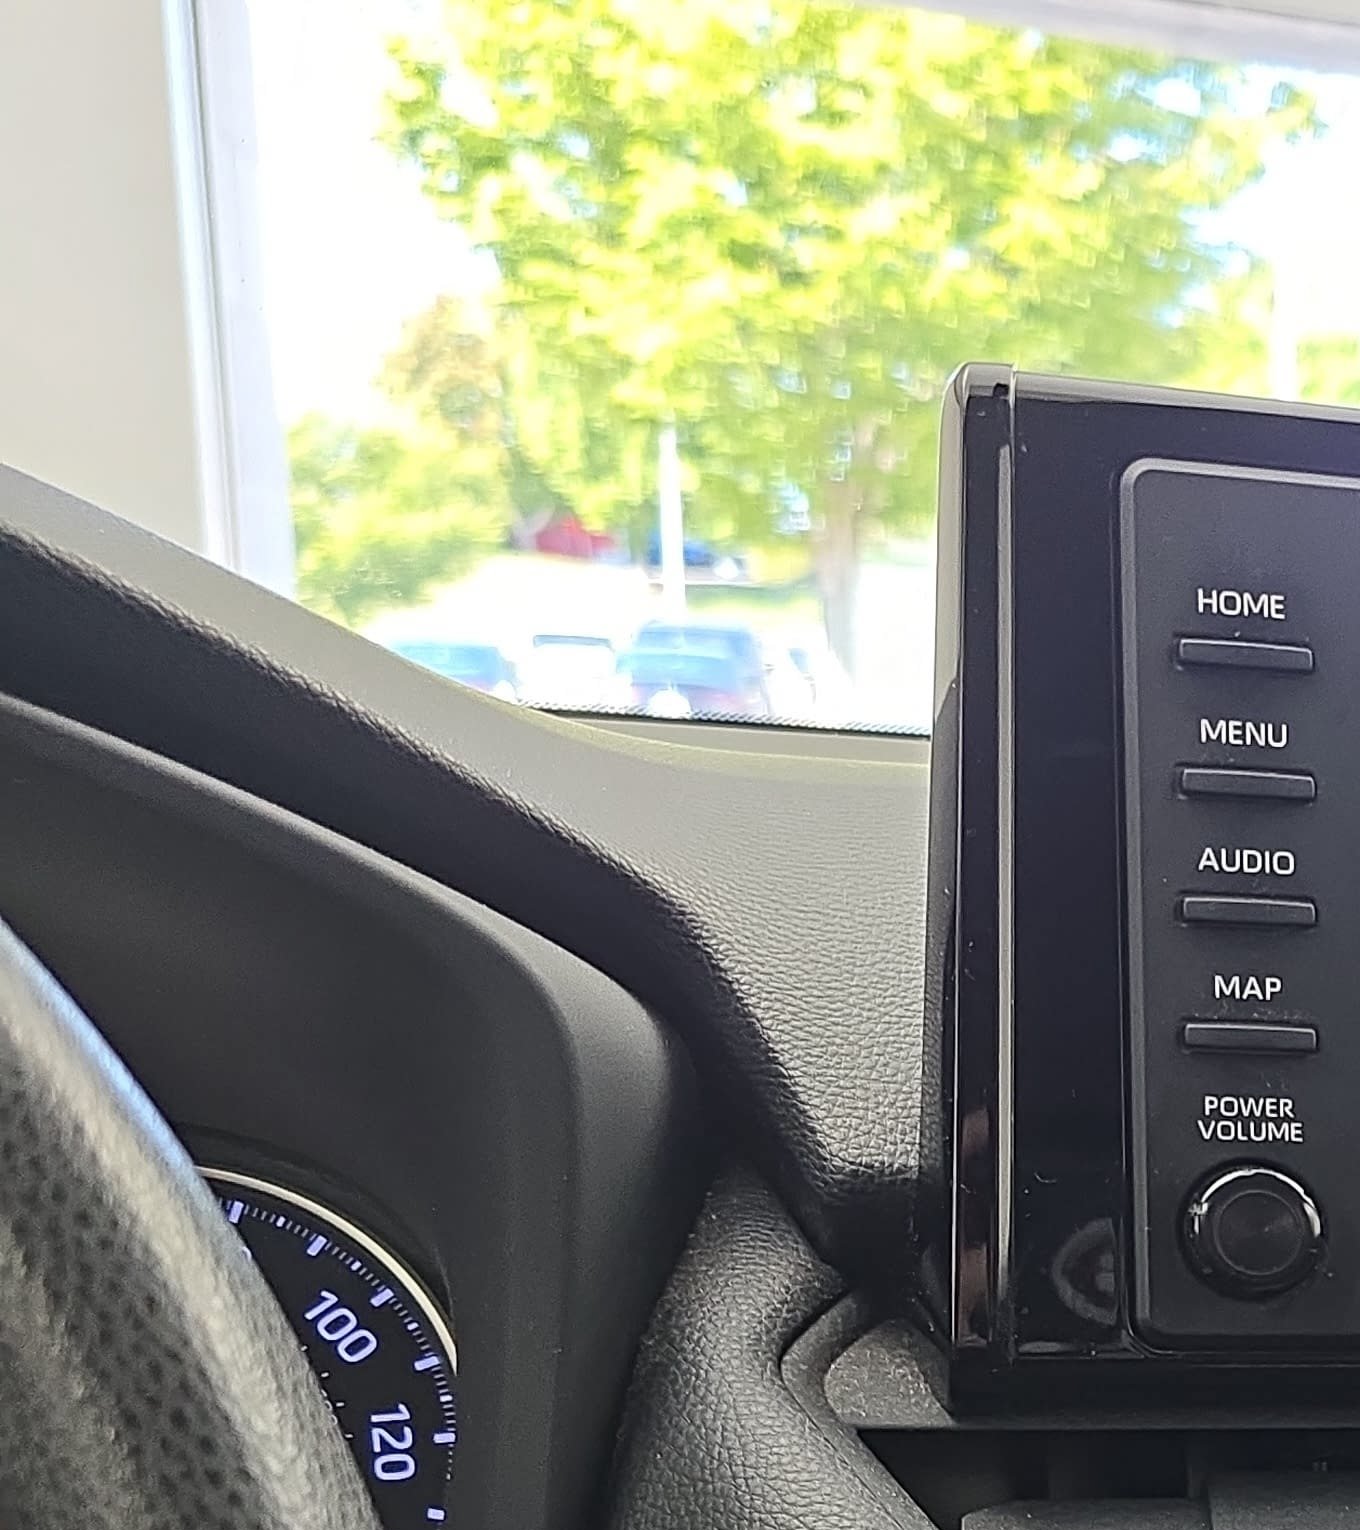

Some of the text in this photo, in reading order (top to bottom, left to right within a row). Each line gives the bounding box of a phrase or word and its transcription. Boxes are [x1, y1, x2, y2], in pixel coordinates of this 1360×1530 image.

[1197, 587, 1286, 620] HOME
[1200, 718, 1287, 748] MENU
[1198, 847, 1295, 875] AUDIO
[1214, 974, 1282, 1001] MAP
[1204, 1095, 1295, 1118] POWER
[1197, 1119, 1304, 1143] VOLUME
[303, 1289, 379, 1364] 100
[370, 1403, 416, 1481] 120
